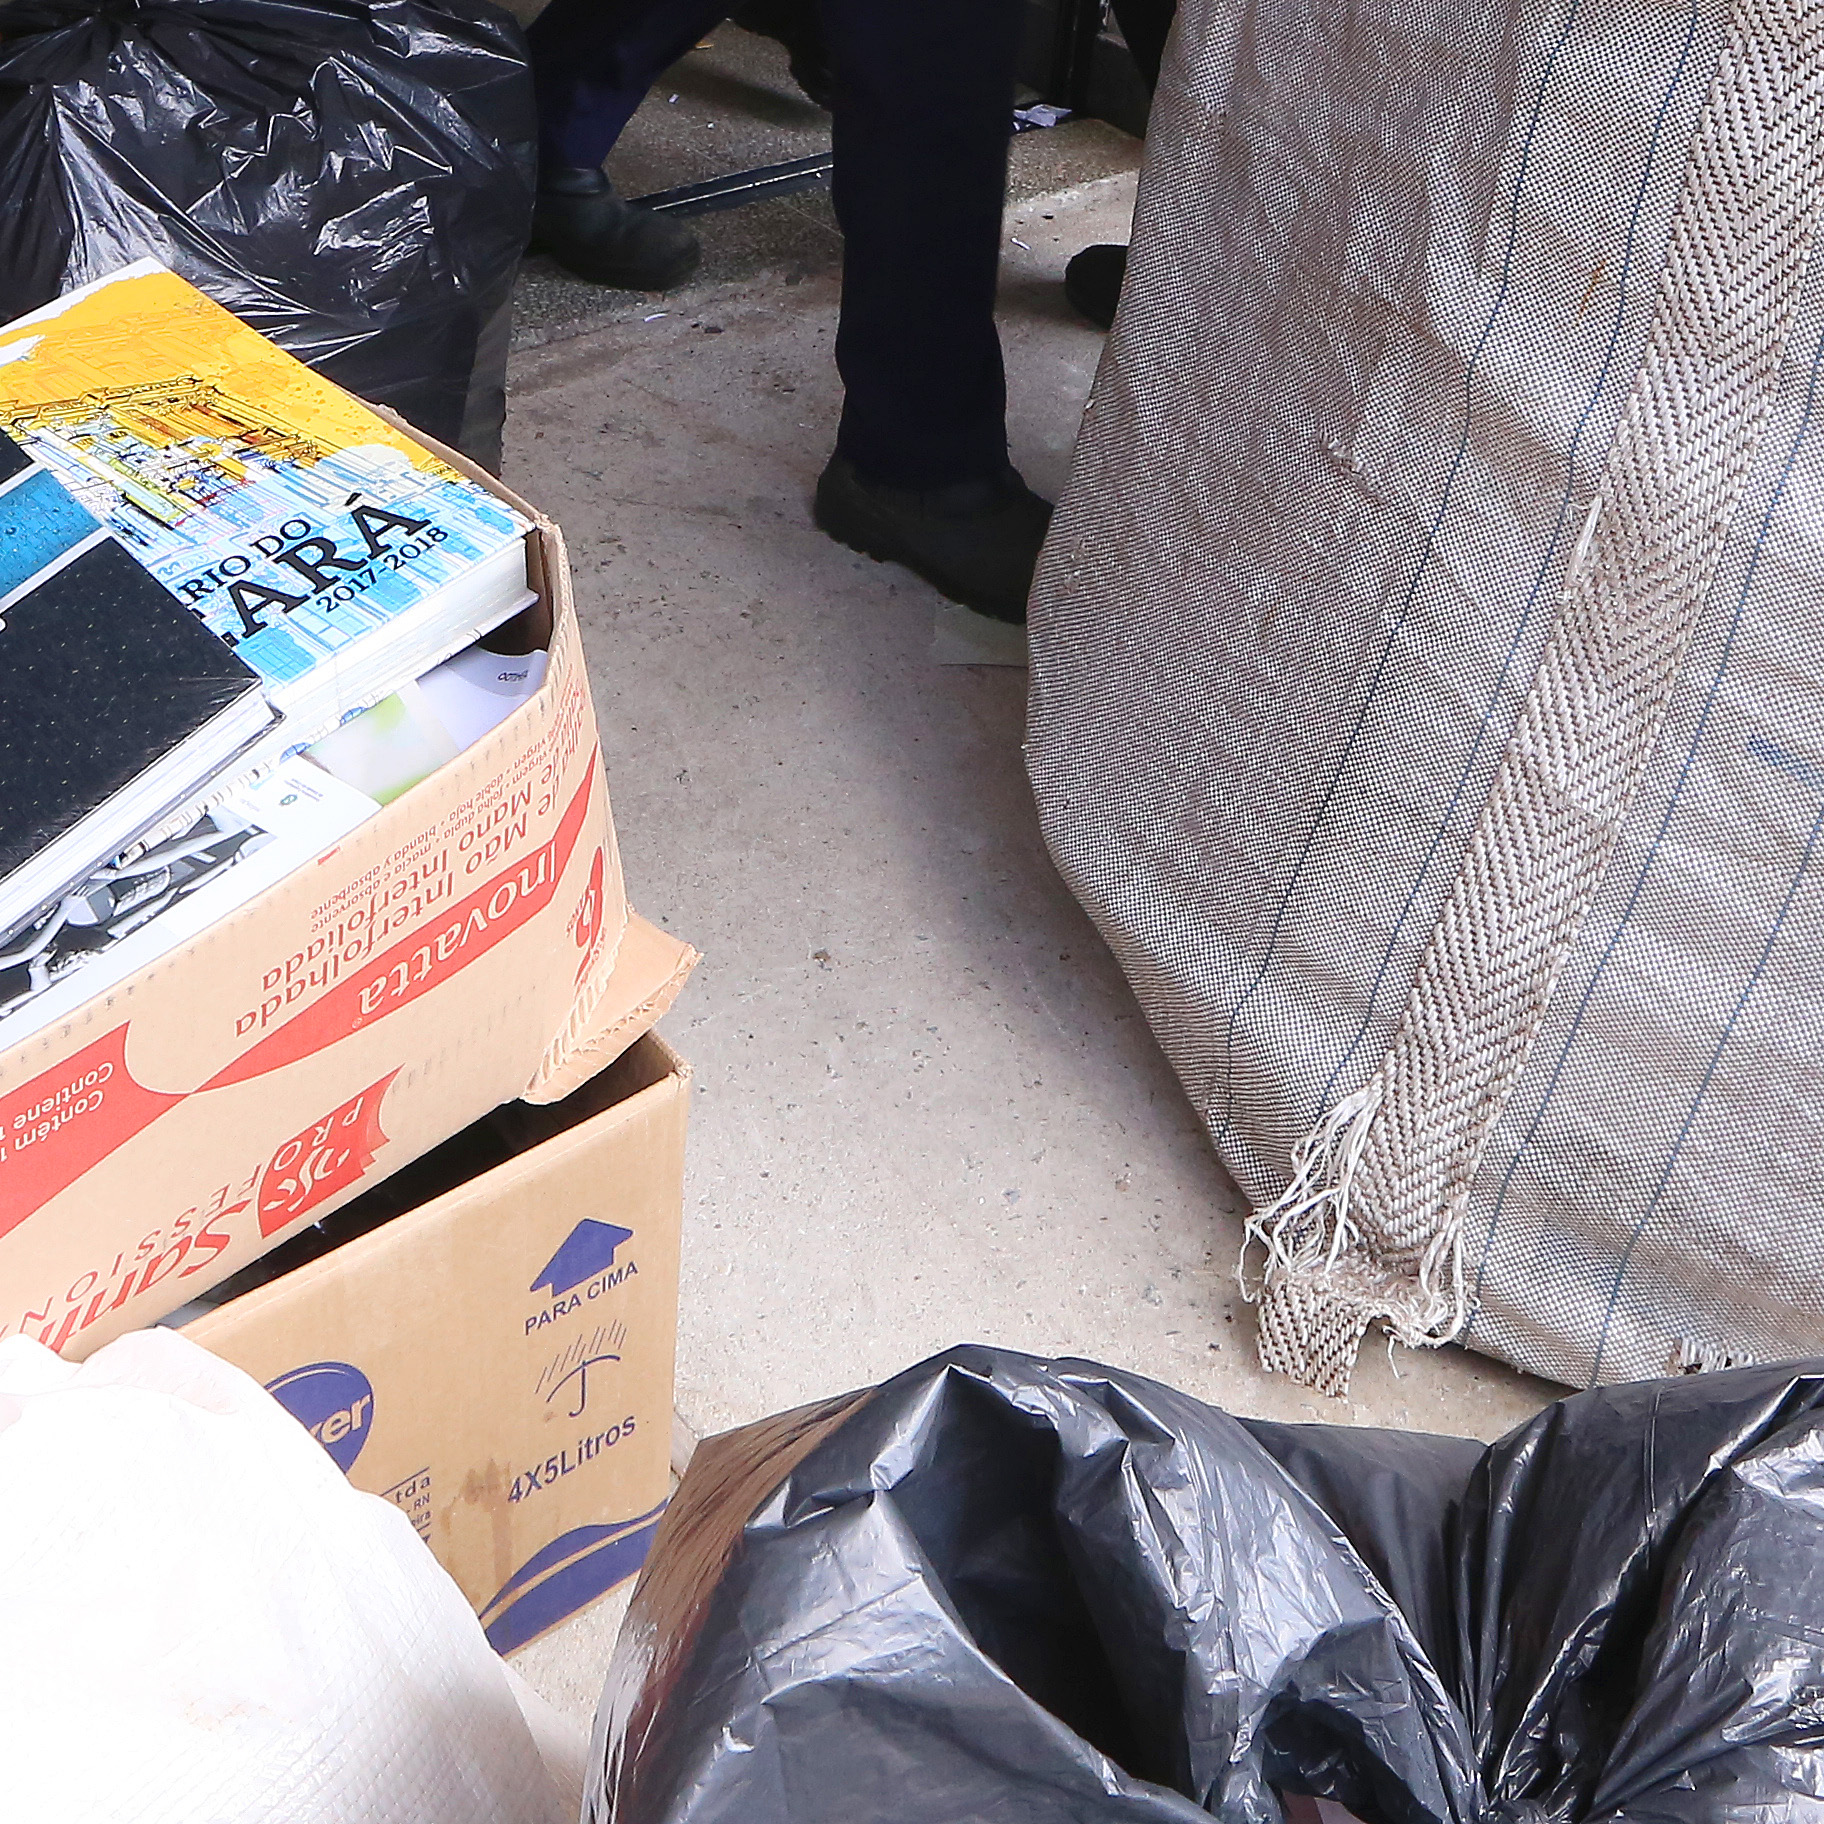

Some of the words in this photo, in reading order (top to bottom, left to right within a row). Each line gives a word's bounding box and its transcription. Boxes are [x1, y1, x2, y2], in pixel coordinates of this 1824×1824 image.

[249, 518, 312, 558] DO
[224, 492, 432, 642] ARÁ
[316, 526, 449, 614] 2017-2018
[447, 796, 474, 823] hoja
[474, 772, 504, 797] doble
[476, 784, 505, 813] folha
[392, 824, 437, 861] blanda
[442, 810, 475, 843] dupla
[457, 777, 532, 853] Mano
[393, 842, 431, 874] macia
[464, 819, 528, 876] Mão
[260, 848, 449, 994] Interfoliada
[308, 867, 380, 920] absorbente
[309, 878, 381, 934] absorvente
[233, 871, 455, 1038] Interfolhada
[11, 1059, 114, 1129] Contiene
[11, 1086, 105, 1153] Contém
[525, 1293, 582, 1336] PARA
[587, 1260, 639, 1301] CIMA
[508, 1414, 637, 1504] 4X5Litros
[414, 1492, 431, 1511] RN
